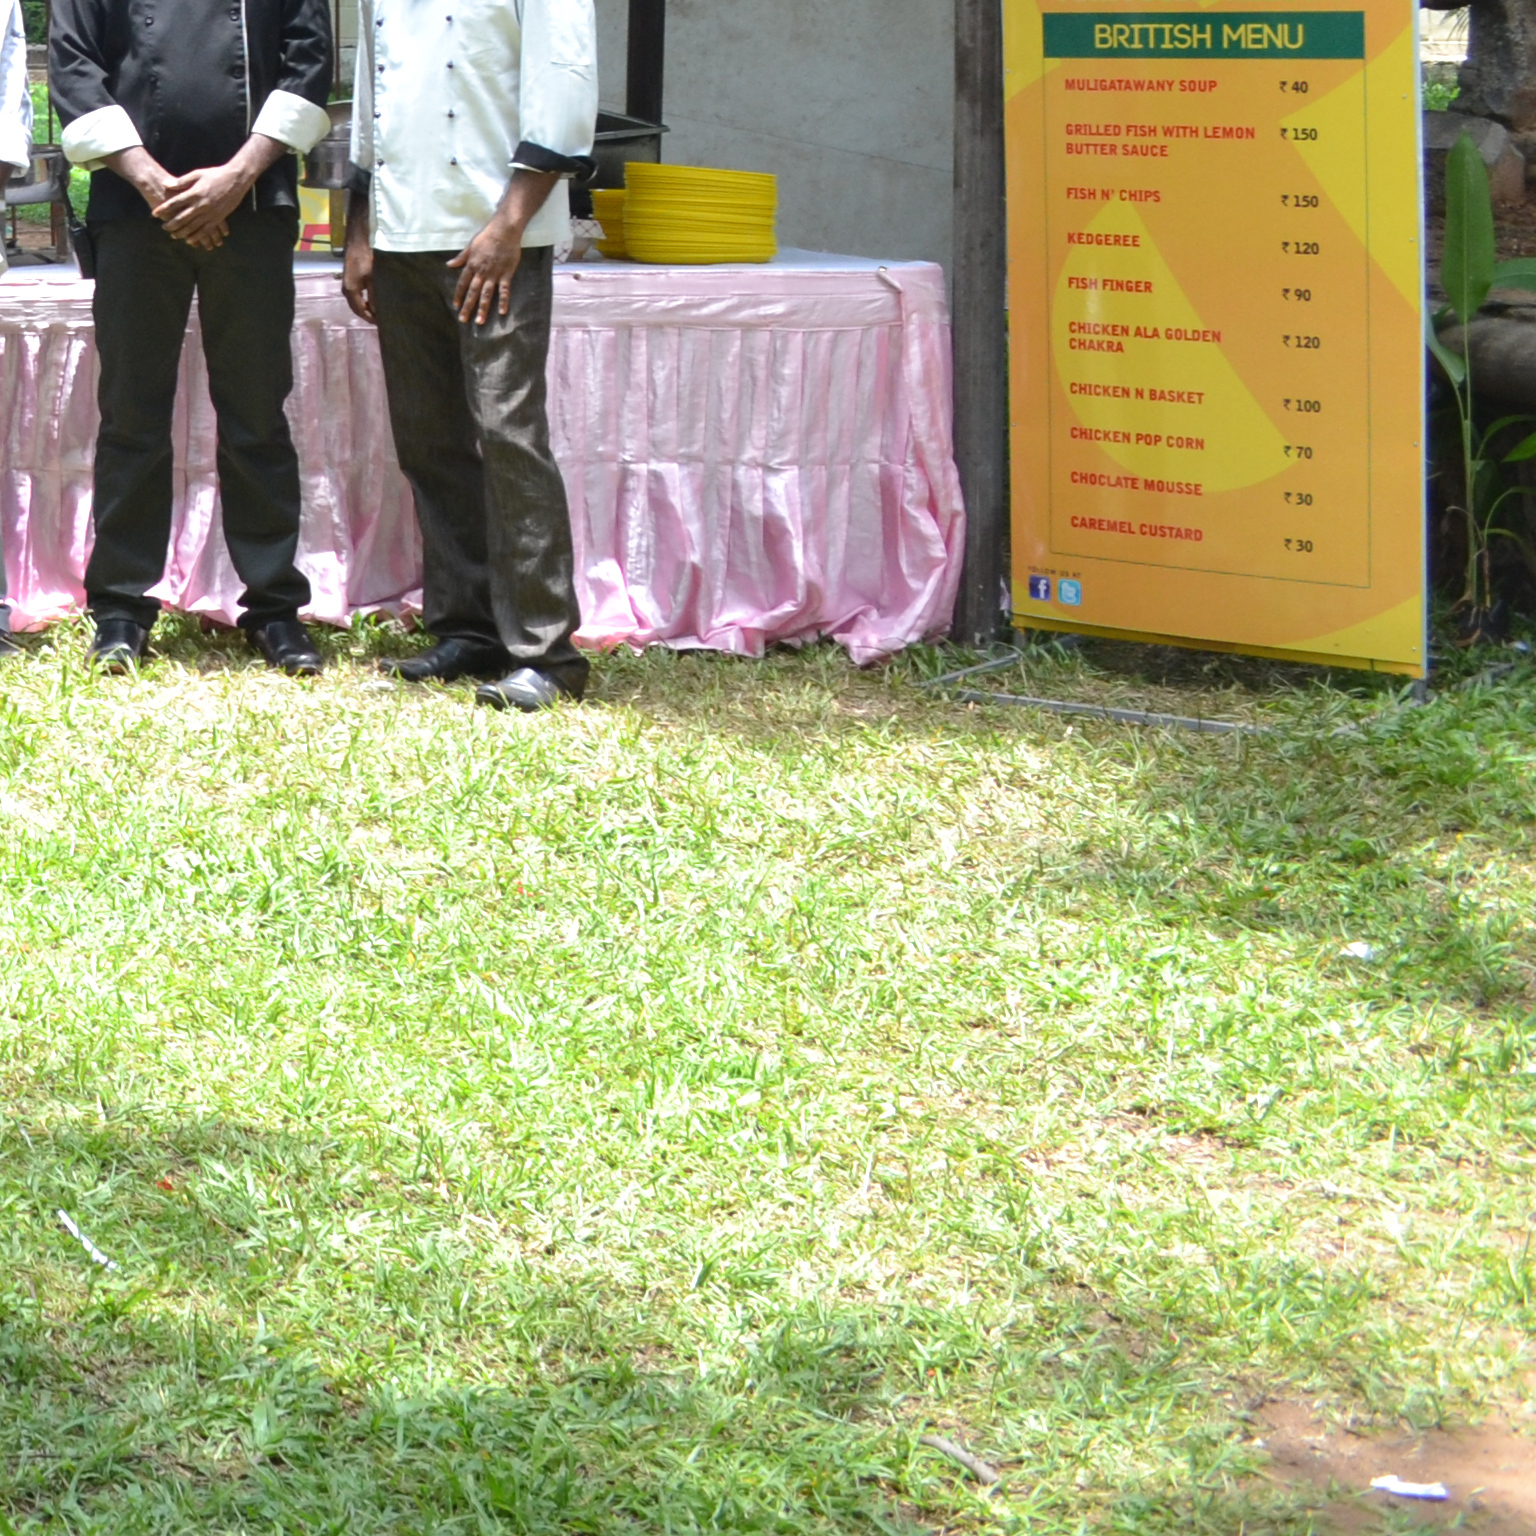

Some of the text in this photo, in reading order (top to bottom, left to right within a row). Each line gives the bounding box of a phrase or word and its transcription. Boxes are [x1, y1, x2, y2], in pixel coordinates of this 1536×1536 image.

[1095, 24, 1303, 49] BRITISH MENU
[1066, 79, 1217, 92] MULIGATAWANY SOUP
[1292, 81, 1308, 93] 40
[1066, 124, 1254, 139] GRILLED FISH WITH LEMON
[1293, 128, 1317, 140] 150
[1066, 143, 1168, 157] BUTTER SAUCE
[1067, 187, 1096, 199] FISH
[1120, 189, 1160, 202] CHIPS
[1294, 195, 1318, 207] 150
[1068, 233, 1140, 247] KEDGEREE
[1295, 242, 1319, 255] 120
[1068, 277, 1152, 293] FISH FINGER
[1294, 289, 1311, 301] 90
[1069, 322, 1221, 342] CHICKEN ALA GOLDEN
[1069, 338, 1124, 353] CHAKRA
[1296, 336, 1320, 349] 120
[1070, 382, 1204, 404] CHICKEN N BASKET
[1296, 400, 1321, 413] 100
[1071, 427, 1204, 450] CHICKEN POP CORN
[1296, 446, 1312, 459] 70
[1071, 471, 1202, 496] CHOCLATE MOUSSE
[1296, 493, 1313, 506] 30
[1071, 516, 1202, 541] CAREMEL CUSTARD
[1296, 540, 1312, 553] 30
